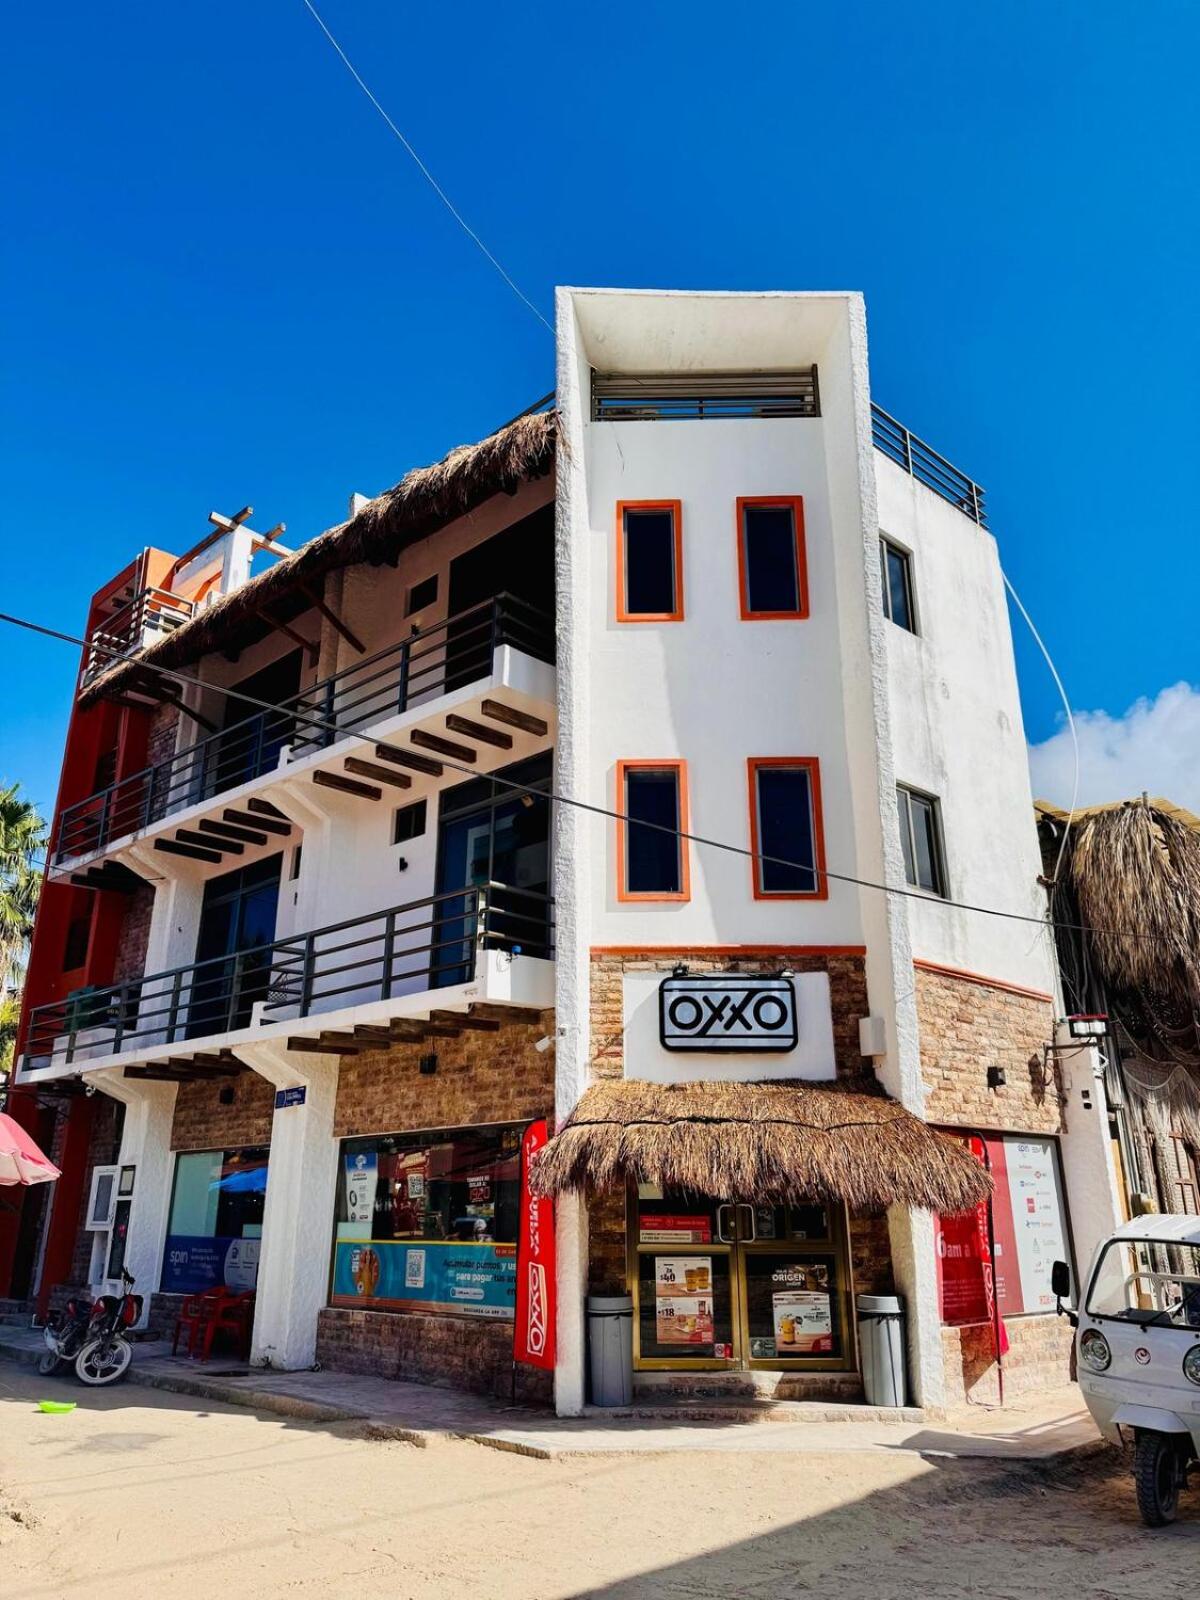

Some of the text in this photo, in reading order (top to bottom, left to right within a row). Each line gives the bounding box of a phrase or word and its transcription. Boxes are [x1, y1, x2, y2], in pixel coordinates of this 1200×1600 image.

[668, 994, 788, 1031] OXXO
[169, 1250, 189, 1266] spin
[501, 1262, 507, 1272] y
[456, 1272, 471, 1281] para
[472, 1273, 493, 1283] pagar
[771, 1273, 805, 1282] ORIGEN
[530, 1267, 544, 1352] OXXO
